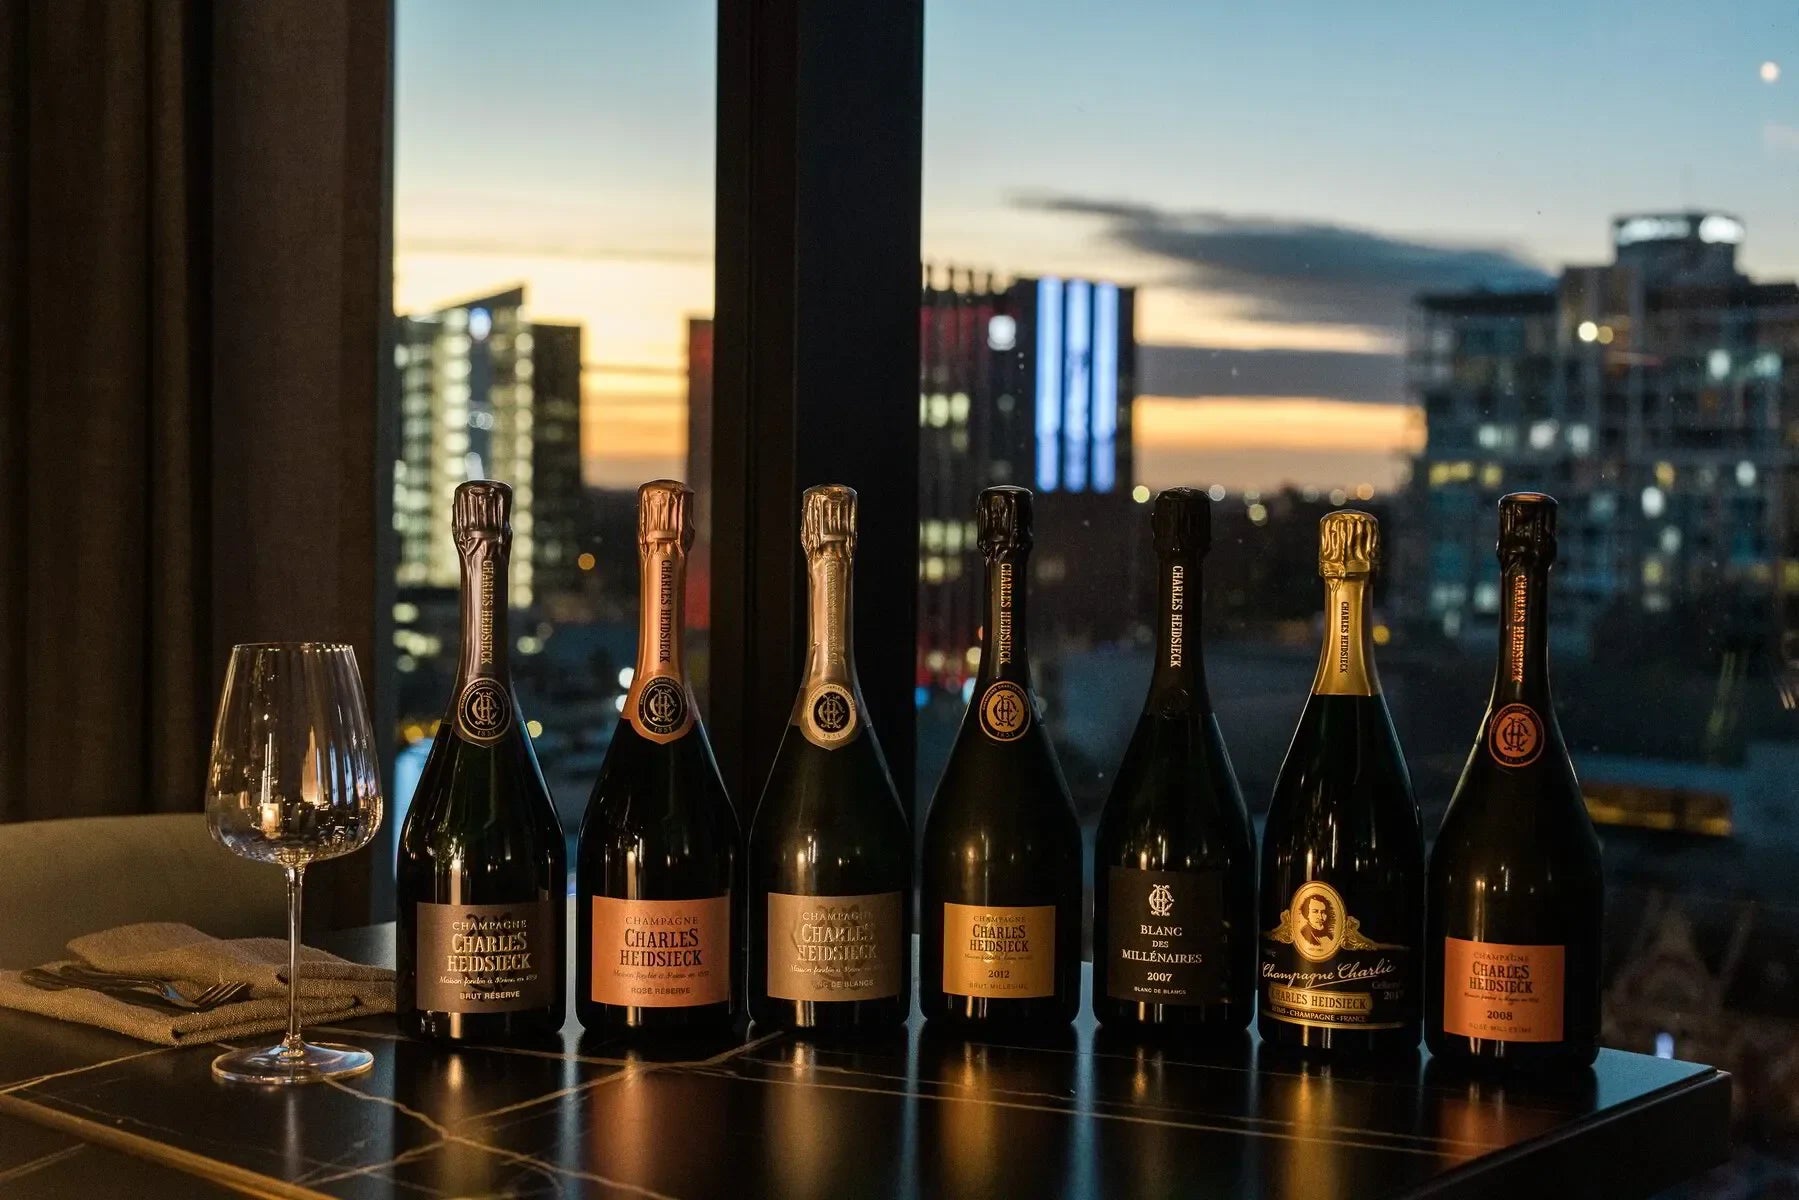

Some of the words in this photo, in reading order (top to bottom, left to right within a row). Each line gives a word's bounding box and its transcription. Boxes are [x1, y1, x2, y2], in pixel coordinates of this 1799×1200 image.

[482, 560, 494, 607] CHARLES
[661, 560, 672, 605] CHARLES
[1001, 563, 1012, 608] CHARLES
[1172, 565, 1184, 611] CHARLES
[1513, 574, 1527, 622] CHARLES
[1341, 601, 1349, 636] CHARLES
[481, 610, 493, 664] HEIDSIECK
[660, 609, 671, 663] HEIDSIECK
[1000, 611, 1011, 665] HEIDSIECK
[1170, 614, 1183, 668] HEIDSIECK
[1340, 636, 1349, 673] HEIDSIECK
[1511, 626, 1525, 684] HEIDSIECK
[452, 920, 527, 931] CHAMPAGNE
[625, 916, 699, 926] CHAMPAGNE
[624, 928, 699, 948] CHARLES
[801, 923, 874, 943] CHARLES
[972, 924, 1026, 939] CHARLES
[1140, 925, 1183, 937] BLANC
[452, 932, 528, 953] CHARLES
[969, 940, 1029, 952] HEIDSIECK
[1152, 940, 1169, 948] DES
[620, 949, 703, 967] HEIDSIECK
[797, 944, 877, 961] HEIDSIECK
[1121, 949, 1203, 964] MILLÉNAIRES
[447, 953, 532, 972] HEIDSIECK
[1472, 961, 1530, 979] CHARLES
[988, 970, 1010, 979] 2012
[1147, 972, 1173, 982] 2007
[1262, 961, 1335, 989] Champagne
[1337, 958, 1397, 980] Charlie
[460, 992, 482, 1000] BRUT
[484, 990, 521, 1000] RÉSERVE
[1469, 977, 1533, 994] HEIDSIECK
[1271, 990, 1308, 1005] CHARLES
[1311, 995, 1368, 1010] HEIDSIECK
[1289, 1010, 1335, 1021] CHAMPAGNE
[1487, 1010, 1513, 1021] 2008
